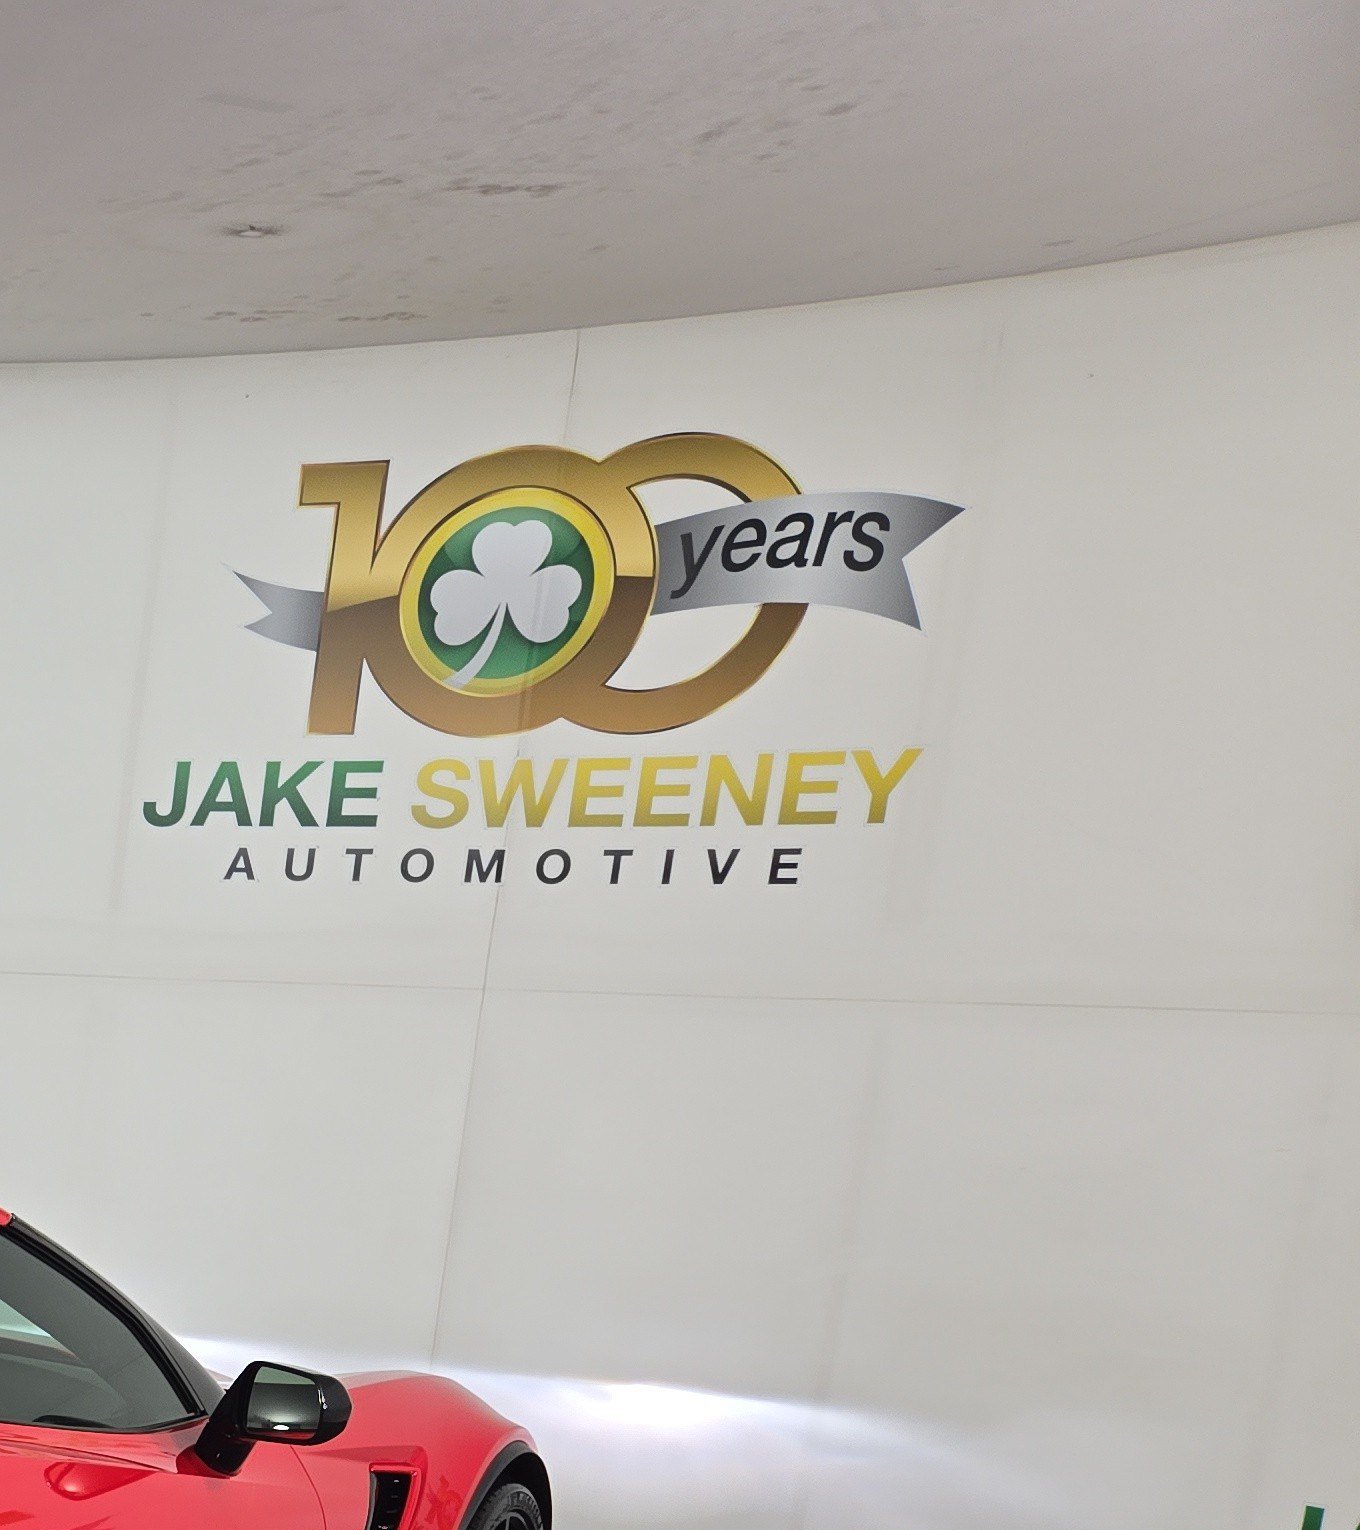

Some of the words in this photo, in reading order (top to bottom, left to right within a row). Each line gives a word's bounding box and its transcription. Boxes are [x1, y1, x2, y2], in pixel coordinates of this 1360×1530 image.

[670, 508, 891, 600] years
[142, 760, 384, 829] JAKE
[409, 747, 924, 830] SWEENEY
[223, 847, 804, 886] AUTOMOTIVE
